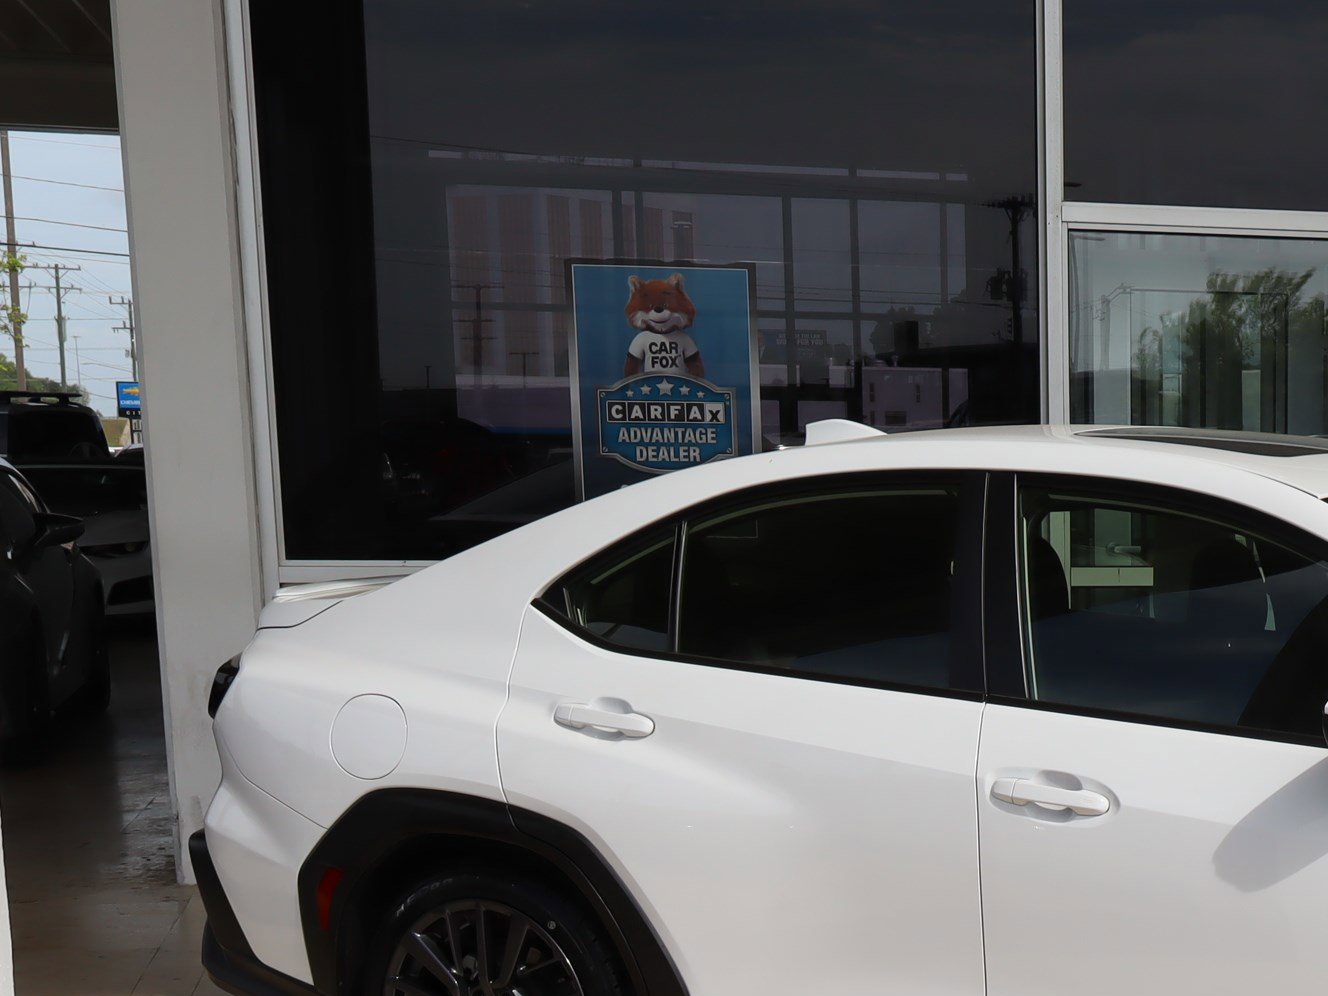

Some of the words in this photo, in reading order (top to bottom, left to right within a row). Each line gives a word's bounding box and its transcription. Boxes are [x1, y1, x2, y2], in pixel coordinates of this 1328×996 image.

[648, 341, 679, 355] CAR
[651, 355, 679, 369] FOX
[610, 404, 721, 423] CARFAX
[618, 427, 717, 444] ADVANTAGE
[636, 446, 700, 462] DEALER
